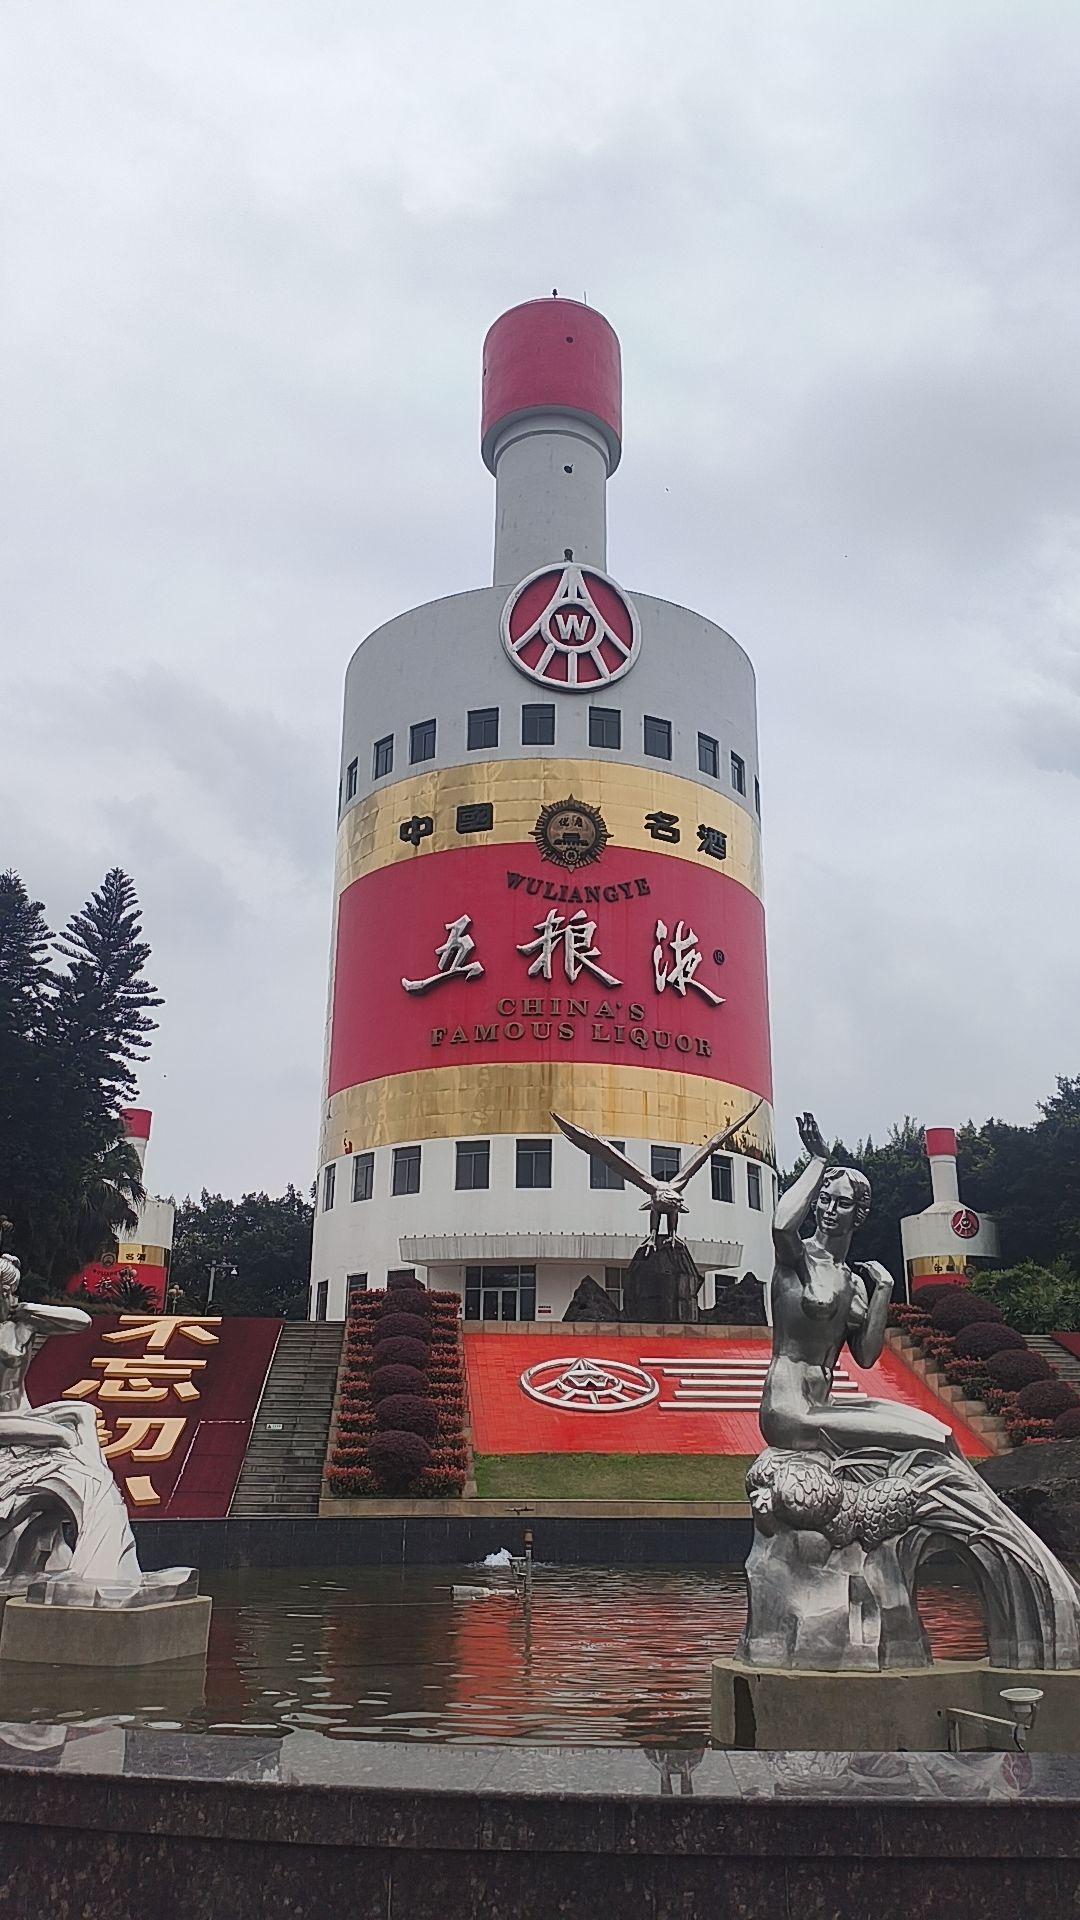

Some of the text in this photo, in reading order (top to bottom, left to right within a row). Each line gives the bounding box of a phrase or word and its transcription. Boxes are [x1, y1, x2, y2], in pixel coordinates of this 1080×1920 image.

[555, 614, 590, 641] W
[507, 871, 651, 903] WULIANGYE
[497, 998, 645, 1021] CHINA'S
[431, 1022, 713, 1057] FAMOUS LIQUOR
